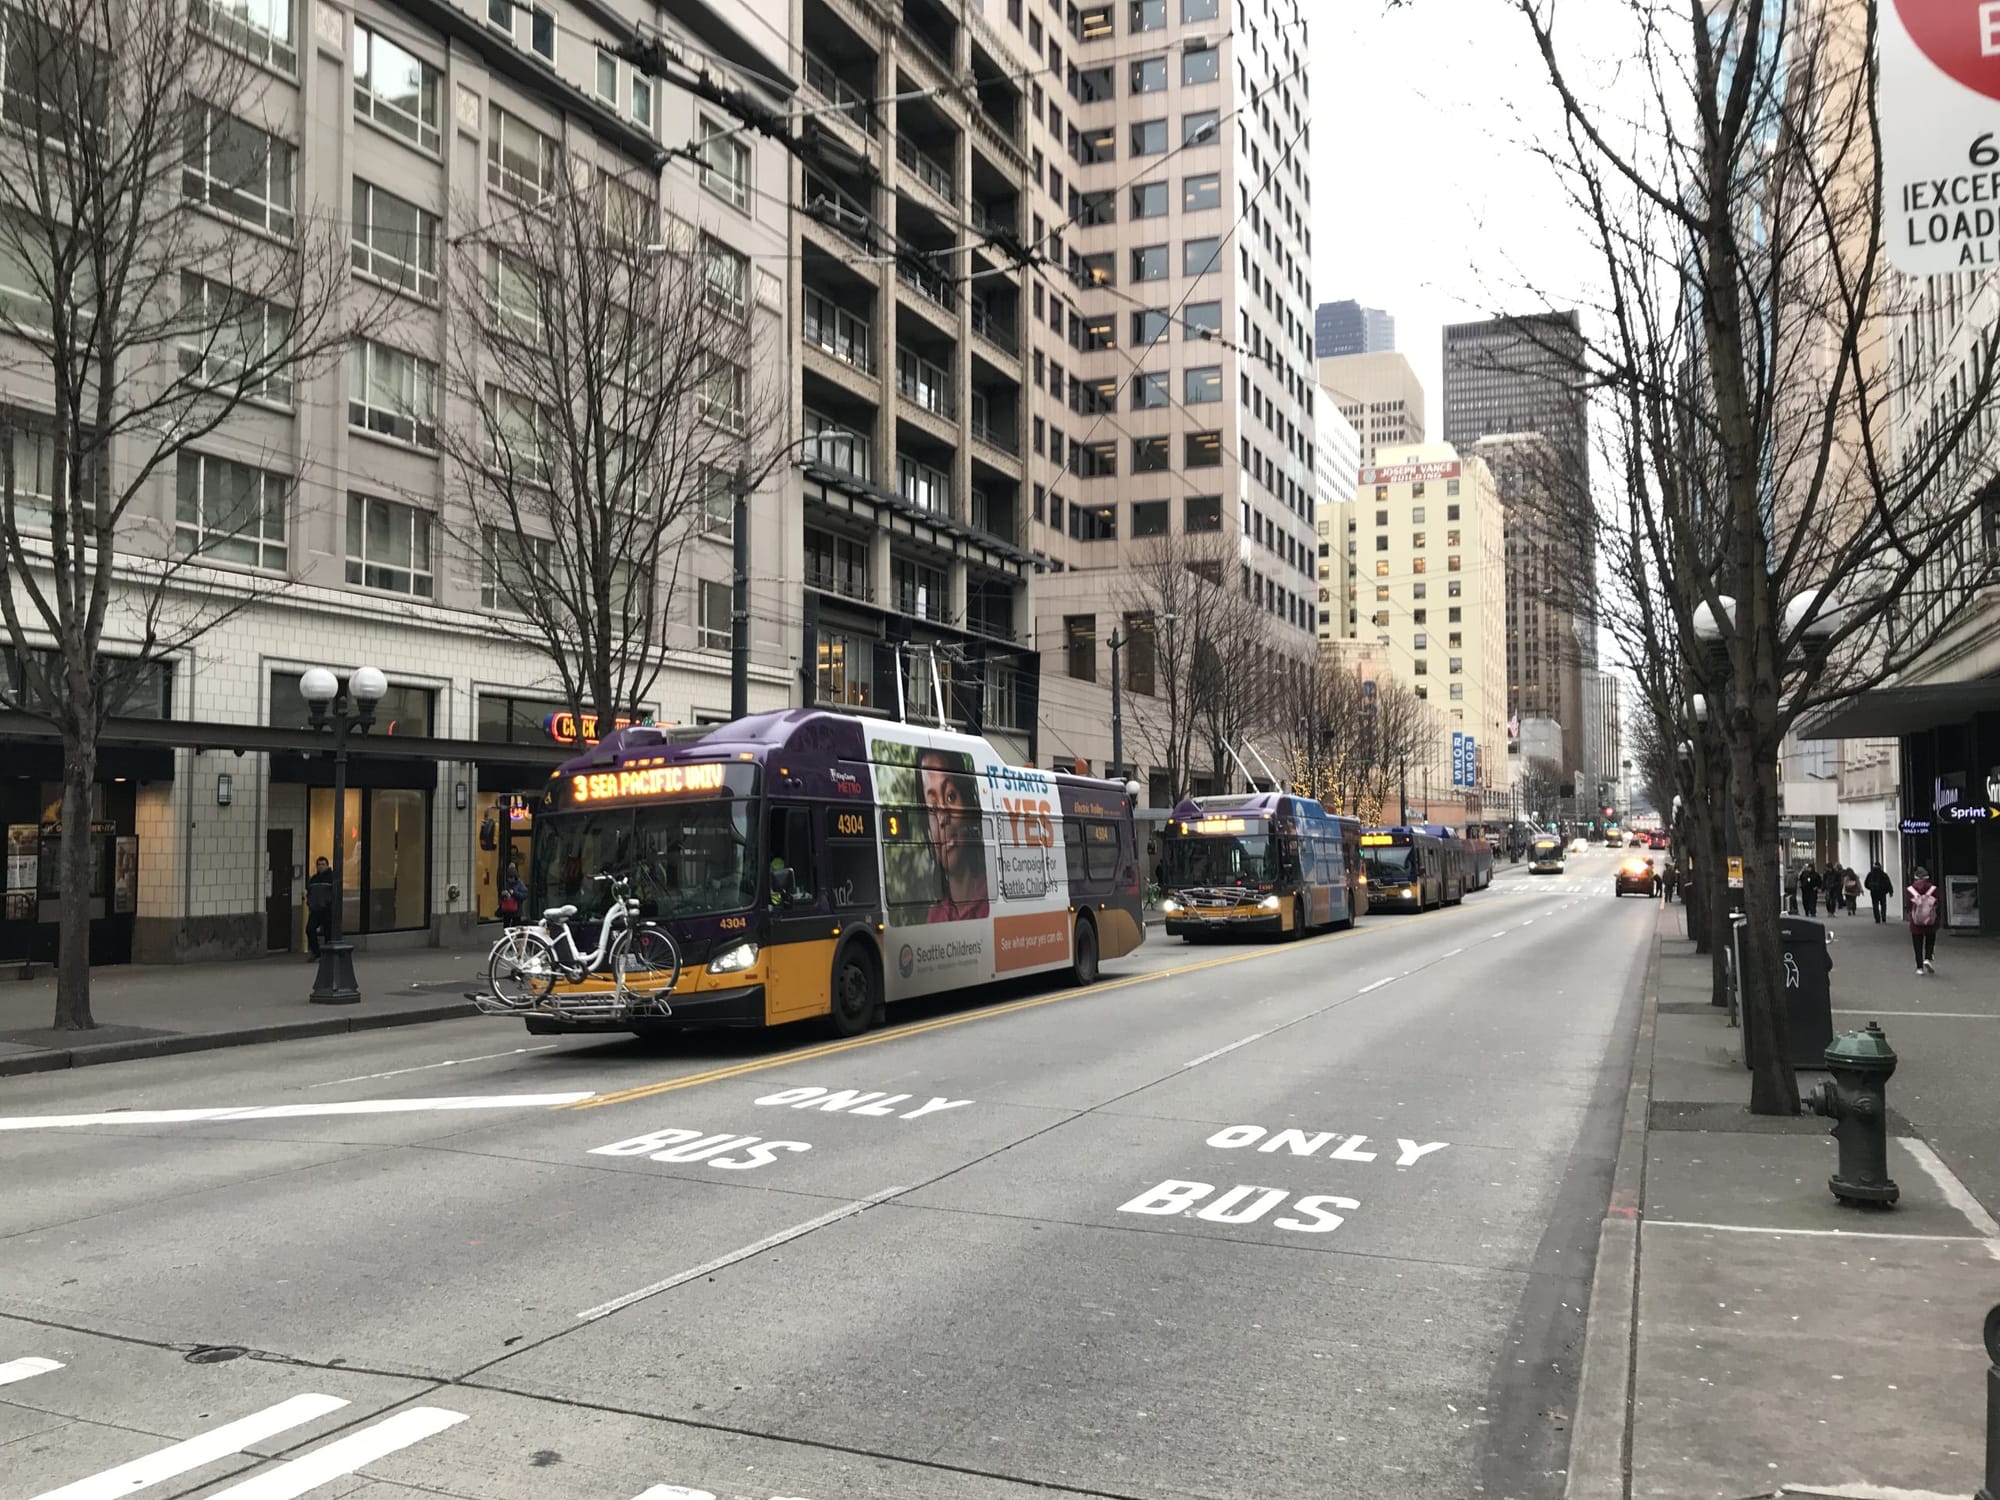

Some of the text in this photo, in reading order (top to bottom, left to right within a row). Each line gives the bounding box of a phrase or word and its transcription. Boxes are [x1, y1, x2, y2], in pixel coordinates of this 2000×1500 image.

[1969, 133, 1999, 167] 6
[1908, 206, 2000, 246] LOAD
[1959, 239, 2000, 266] AL
[1381, 463, 1452, 478] JOSEPH VANCE
[562, 718, 596, 738] CHCK
[1453, 737, 1462, 780] ROSS
[1466, 741, 1474, 782] ROSS
[573, 763, 723, 801] 3 SEA PACIFIC UNIV
[838, 781, 862, 794] METRO
[987, 765, 1049, 794] IT STARTS
[838, 814, 864, 834] 4304
[889, 817, 898, 835] 3
[1003, 797, 1055, 848] YES
[1950, 806, 1986, 819] Sprint
[998, 857, 1011, 872] The
[999, 880, 1025, 895] Seattle
[720, 917, 747, 929] 4304
[917, 939, 982, 963] Seattle Children's
[1001, 937, 1011, 951] See
[1012, 935, 1025, 948] what
[1025, 935, 1038, 950] your
[753, 1086, 977, 1119] ONLY
[586, 1128, 813, 1169] BUS
[1206, 1125, 1450, 1166] ONLY
[1116, 1179, 1361, 1233] BUS
